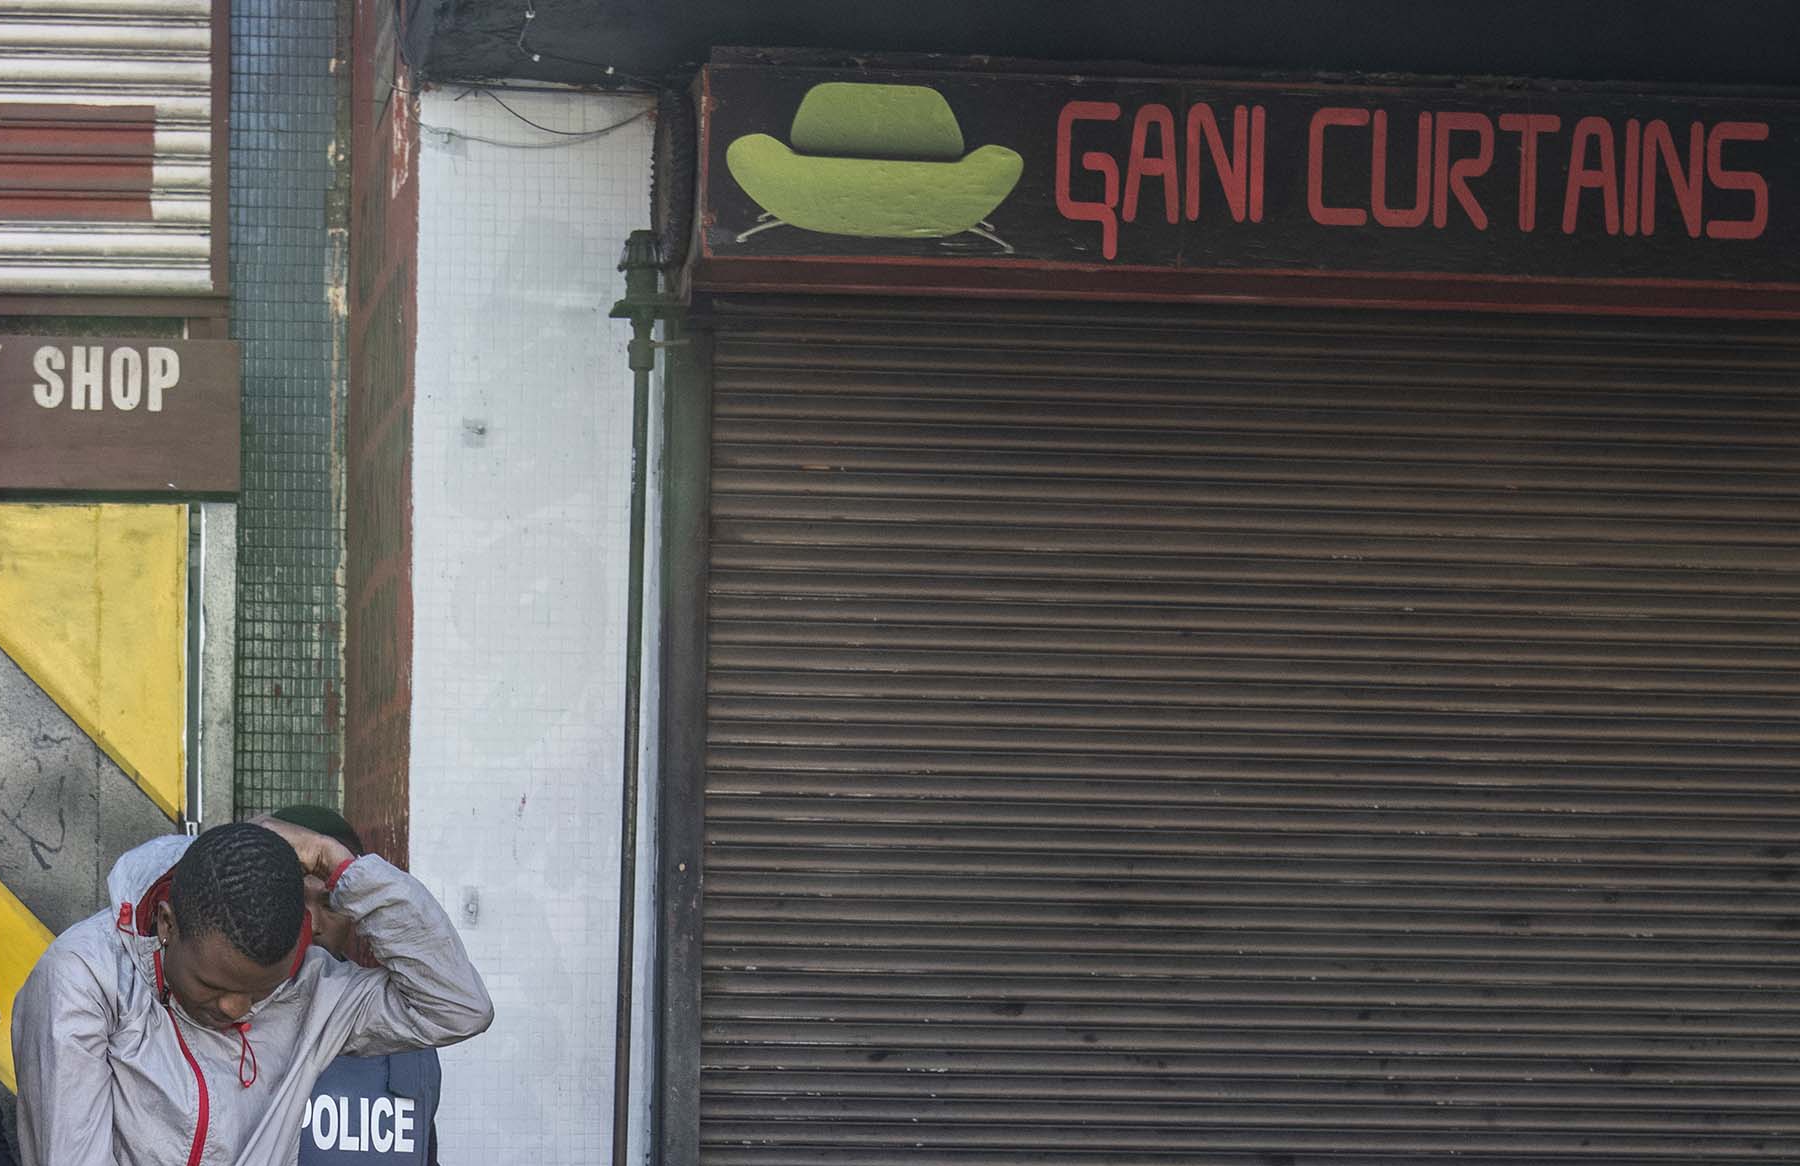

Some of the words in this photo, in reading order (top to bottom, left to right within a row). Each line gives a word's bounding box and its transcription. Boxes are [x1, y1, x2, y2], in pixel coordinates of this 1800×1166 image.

[1055, 101, 1266, 260] GANI
[1307, 107, 1770, 240] CURTAINS
[32, 346, 180, 412] SHOP
